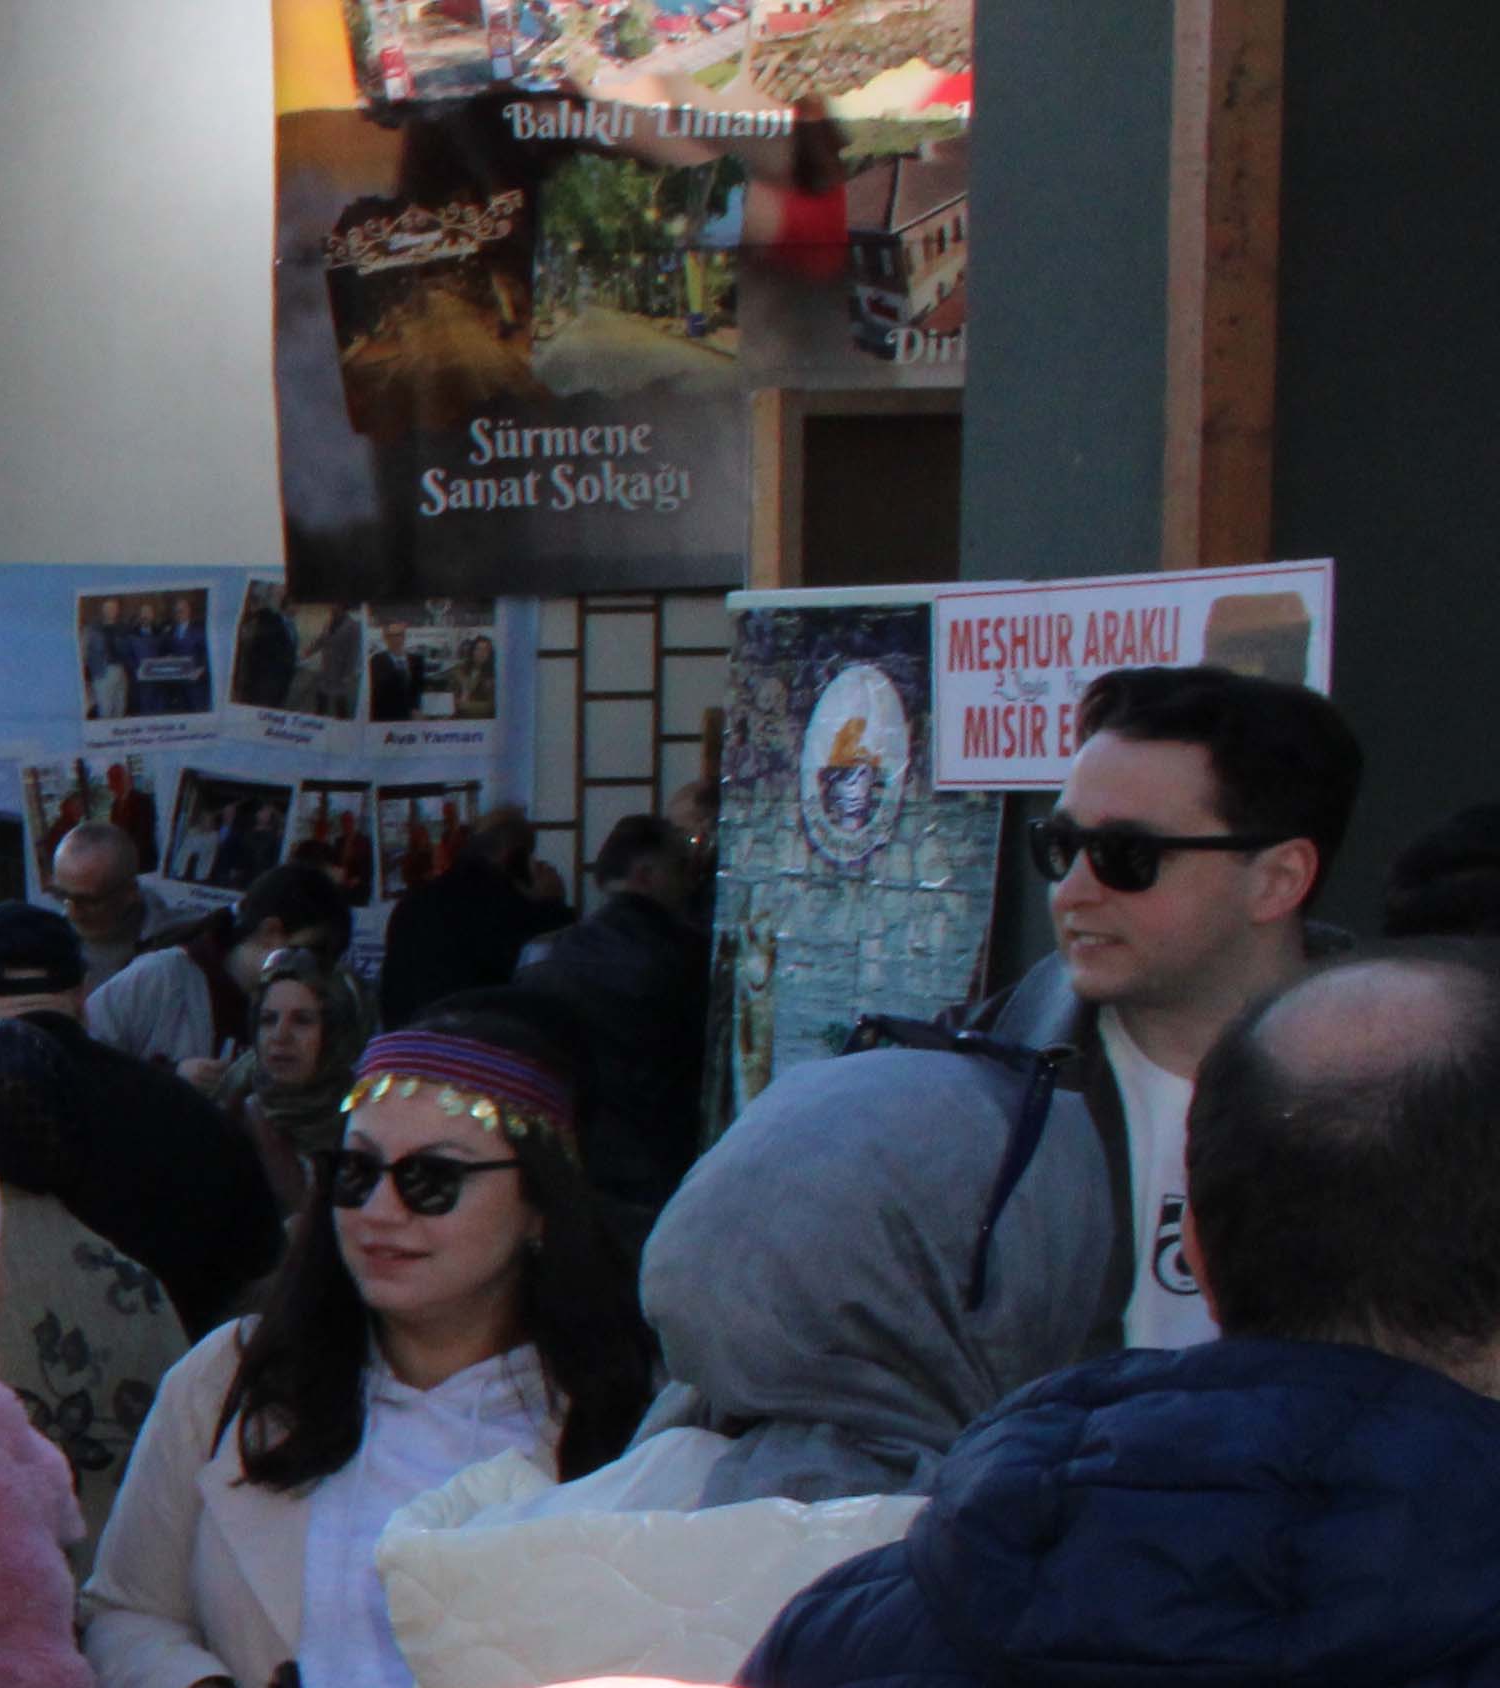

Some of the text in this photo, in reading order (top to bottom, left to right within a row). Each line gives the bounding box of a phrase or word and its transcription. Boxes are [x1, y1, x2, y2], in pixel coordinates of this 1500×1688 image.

[502, 101, 792, 147] Balıklı Limanı
[470, 417, 653, 466] Sürmene
[420, 462, 690, 516] Sanat Sokağı
[948, 605, 1182, 684] MEŞHUR ARAKLI
[962, 704, 1047, 760] MISIR
